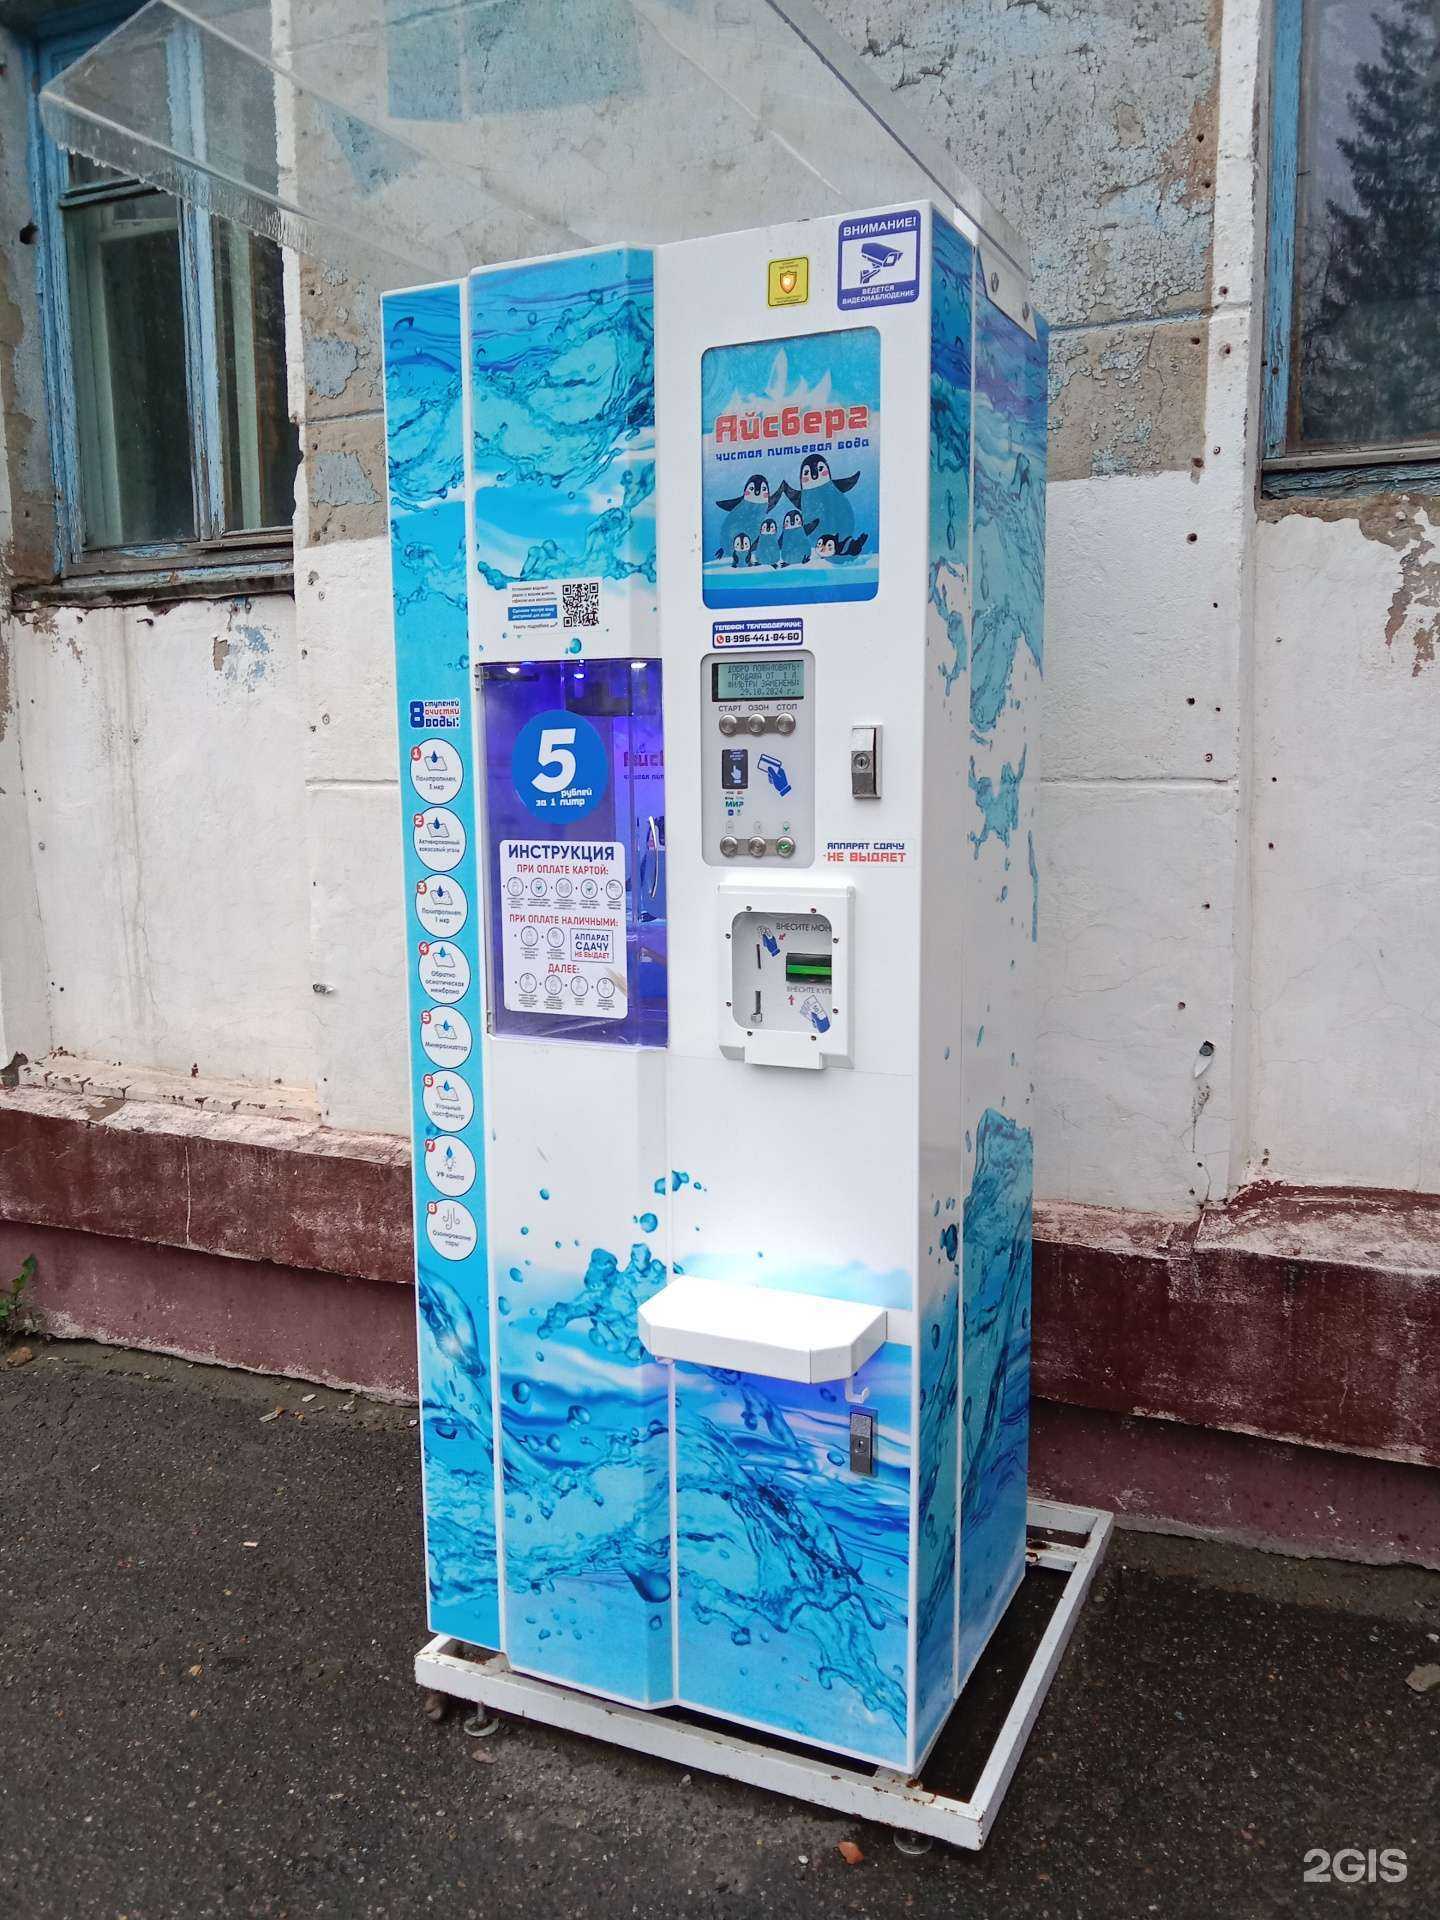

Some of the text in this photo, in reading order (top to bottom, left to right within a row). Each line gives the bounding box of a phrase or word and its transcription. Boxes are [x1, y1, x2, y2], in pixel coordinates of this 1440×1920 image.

[843, 216, 917, 237] ВНИМАНИЕ!
[862, 285, 895, 295] ВЕДЕТСЯ
[842, 290, 916, 305] ВИДЕОНАБЛЮДЕНИЕ
[715, 405, 870, 444] Айсберг
[715, 437, 870, 462] чистая питьевая вода
[714, 624, 745, 632] ТЕЛЕФОН
[725, 632, 800, 643] 8-996-441-84-60
[424, 699, 460, 708] ступеней
[748, 704, 770, 712] ОЗОН
[409, 700, 425, 729] 8
[424, 708, 460, 716] очистки
[425, 716, 460, 728] воды:
[531, 728, 577, 794] 5
[561, 787, 593, 799] рублей
[535, 798, 586, 808] за 1 литр
[725, 800, 745, 808] МИР
[827, 842, 905, 850] АППАРАТ СДАЧУ
[508, 844, 615, 863] ИНСТРУКЦИЯ
[827, 852, 906, 862] НЕ ВЫДАЕТ
[517, 864, 610, 876] ПРИ ОПЛАТЕ КАРТОЙ:
[509, 914, 620, 927] ПРИ ОПЛАТЕ НАЛИЧНЫМИ:
[776, 922, 810, 932] ВНЕСИТЕ
[574, 933, 609, 942] АППАРАТ
[575, 942, 609, 952] СДАЧУ
[584, 952, 610, 960] ВЫДАЕТ
[548, 963, 581, 975] ДАЛЕЕ:
